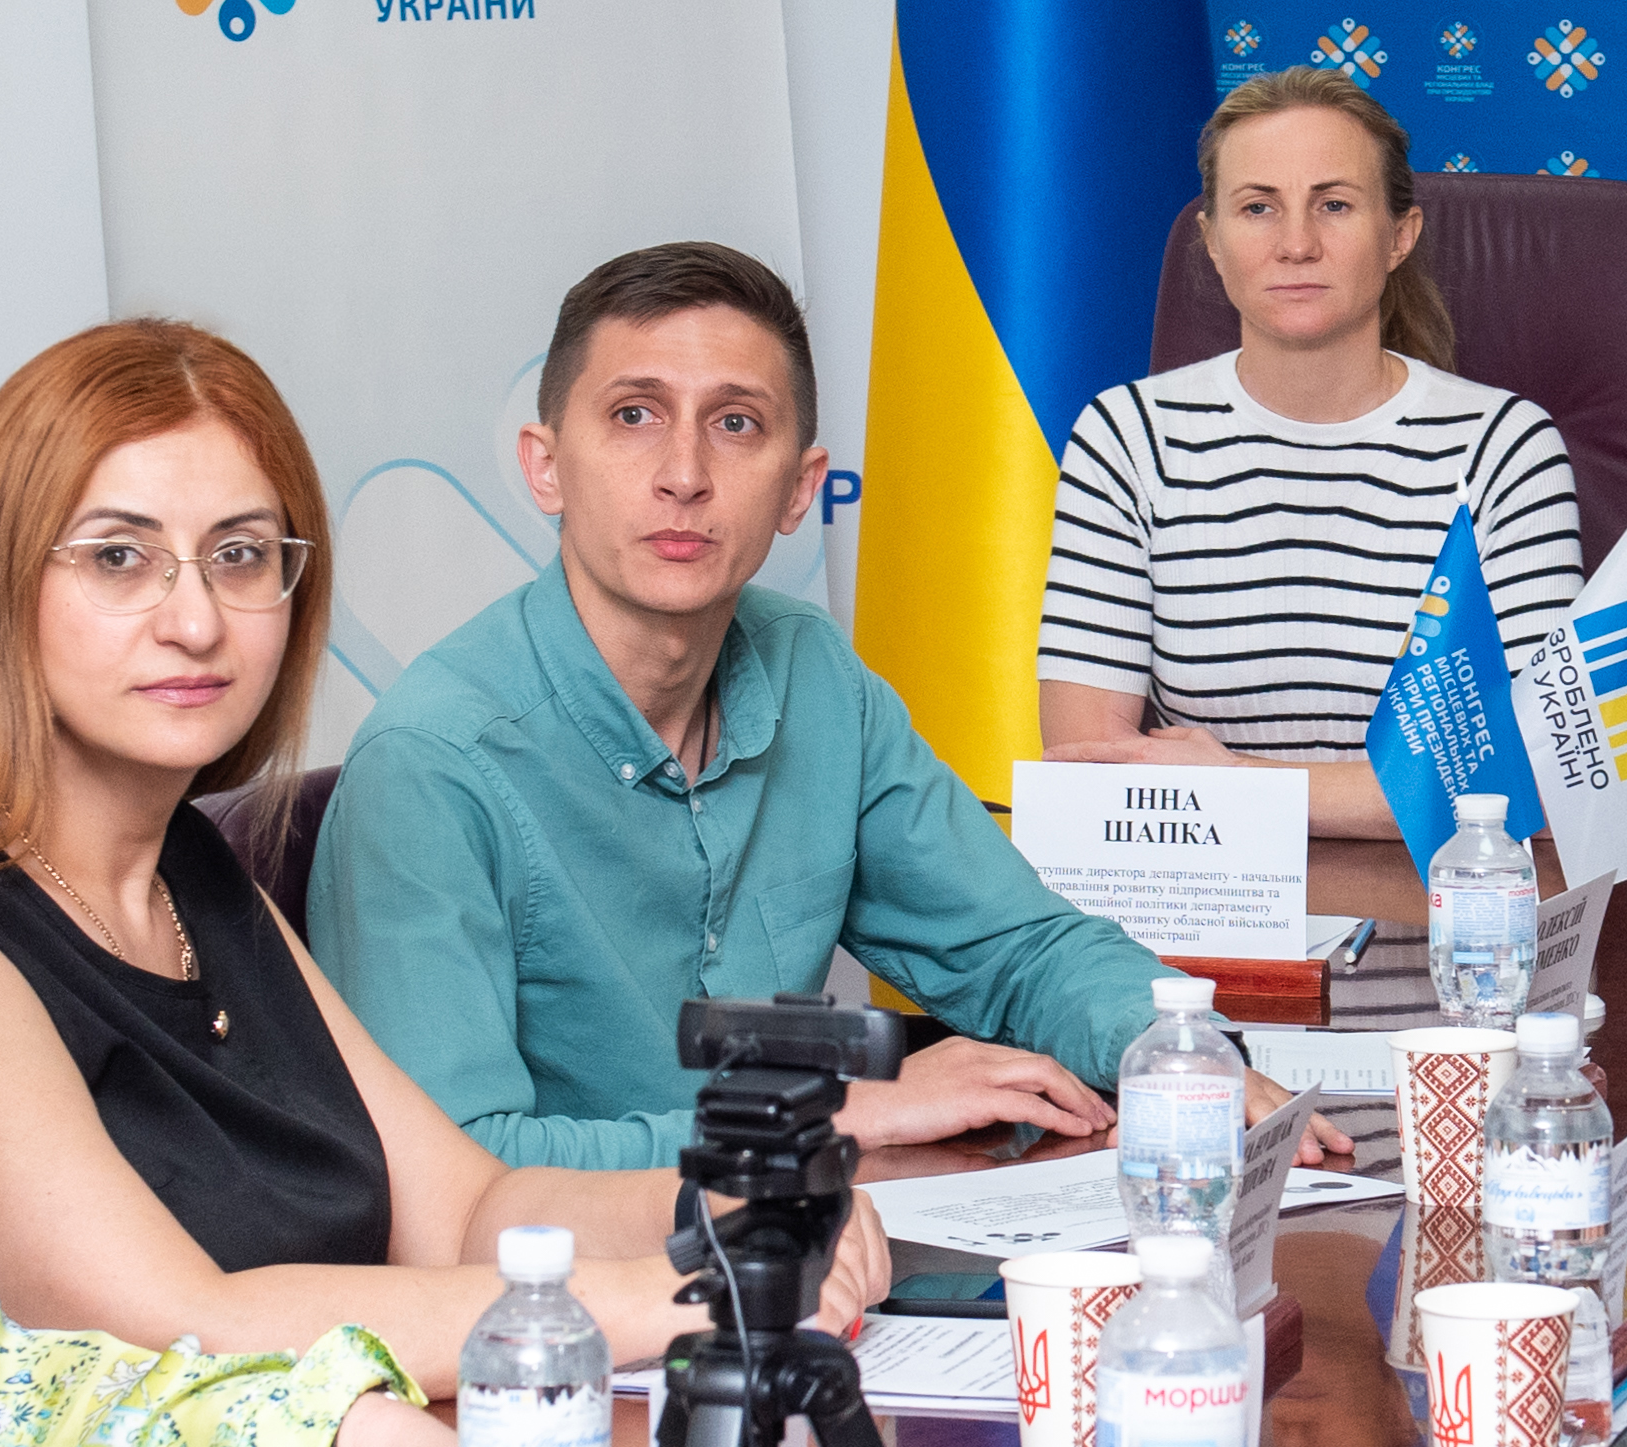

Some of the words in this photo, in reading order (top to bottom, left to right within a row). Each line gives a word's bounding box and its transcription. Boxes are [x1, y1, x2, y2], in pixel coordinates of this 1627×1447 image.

[1531, 647, 1547, 667] В
[1387, 682, 1426, 756] УКРАЇНИ
[1417, 663, 1470, 792] РЕГІОНАЛЬНИХ
[1434, 656, 1473, 748] МІСЦЕВИХ
[1464, 749, 1479, 774] ТА
[1451, 648, 1494, 762] КОНГРЕС
[1533, 670, 1584, 789] УКРАЇНІ
[1549, 628, 1609, 790] ЗРОБЛЕНО
[1400, 673, 1425, 709] ПРИ
[1415, 704, 1464, 831] ПРЕЗИДЕН
[1125, 787, 1202, 811] ІННА
[1103, 819, 1222, 845] ШАПКА
[1034, 866, 1083, 878] ступник
[1086, 867, 1146, 880] директора
[1149, 869, 1230, 883] департаменту
[1241, 873, 1303, 884] начальник
[1044, 880, 1110, 894] управління
[1113, 883, 1166, 896] розвитку
[1169, 884, 1265, 899] підприємництва
[1267, 889, 1280, 898] та
[1068, 896, 1133, 908] естиційної
[1135, 898, 1187, 912] політики
[1190, 901, 1272, 916] департаменту
[1118, 915, 1170, 928] розвитку
[1173, 915, 1226, 928] обласної
[1228, 916, 1290, 930] військової
